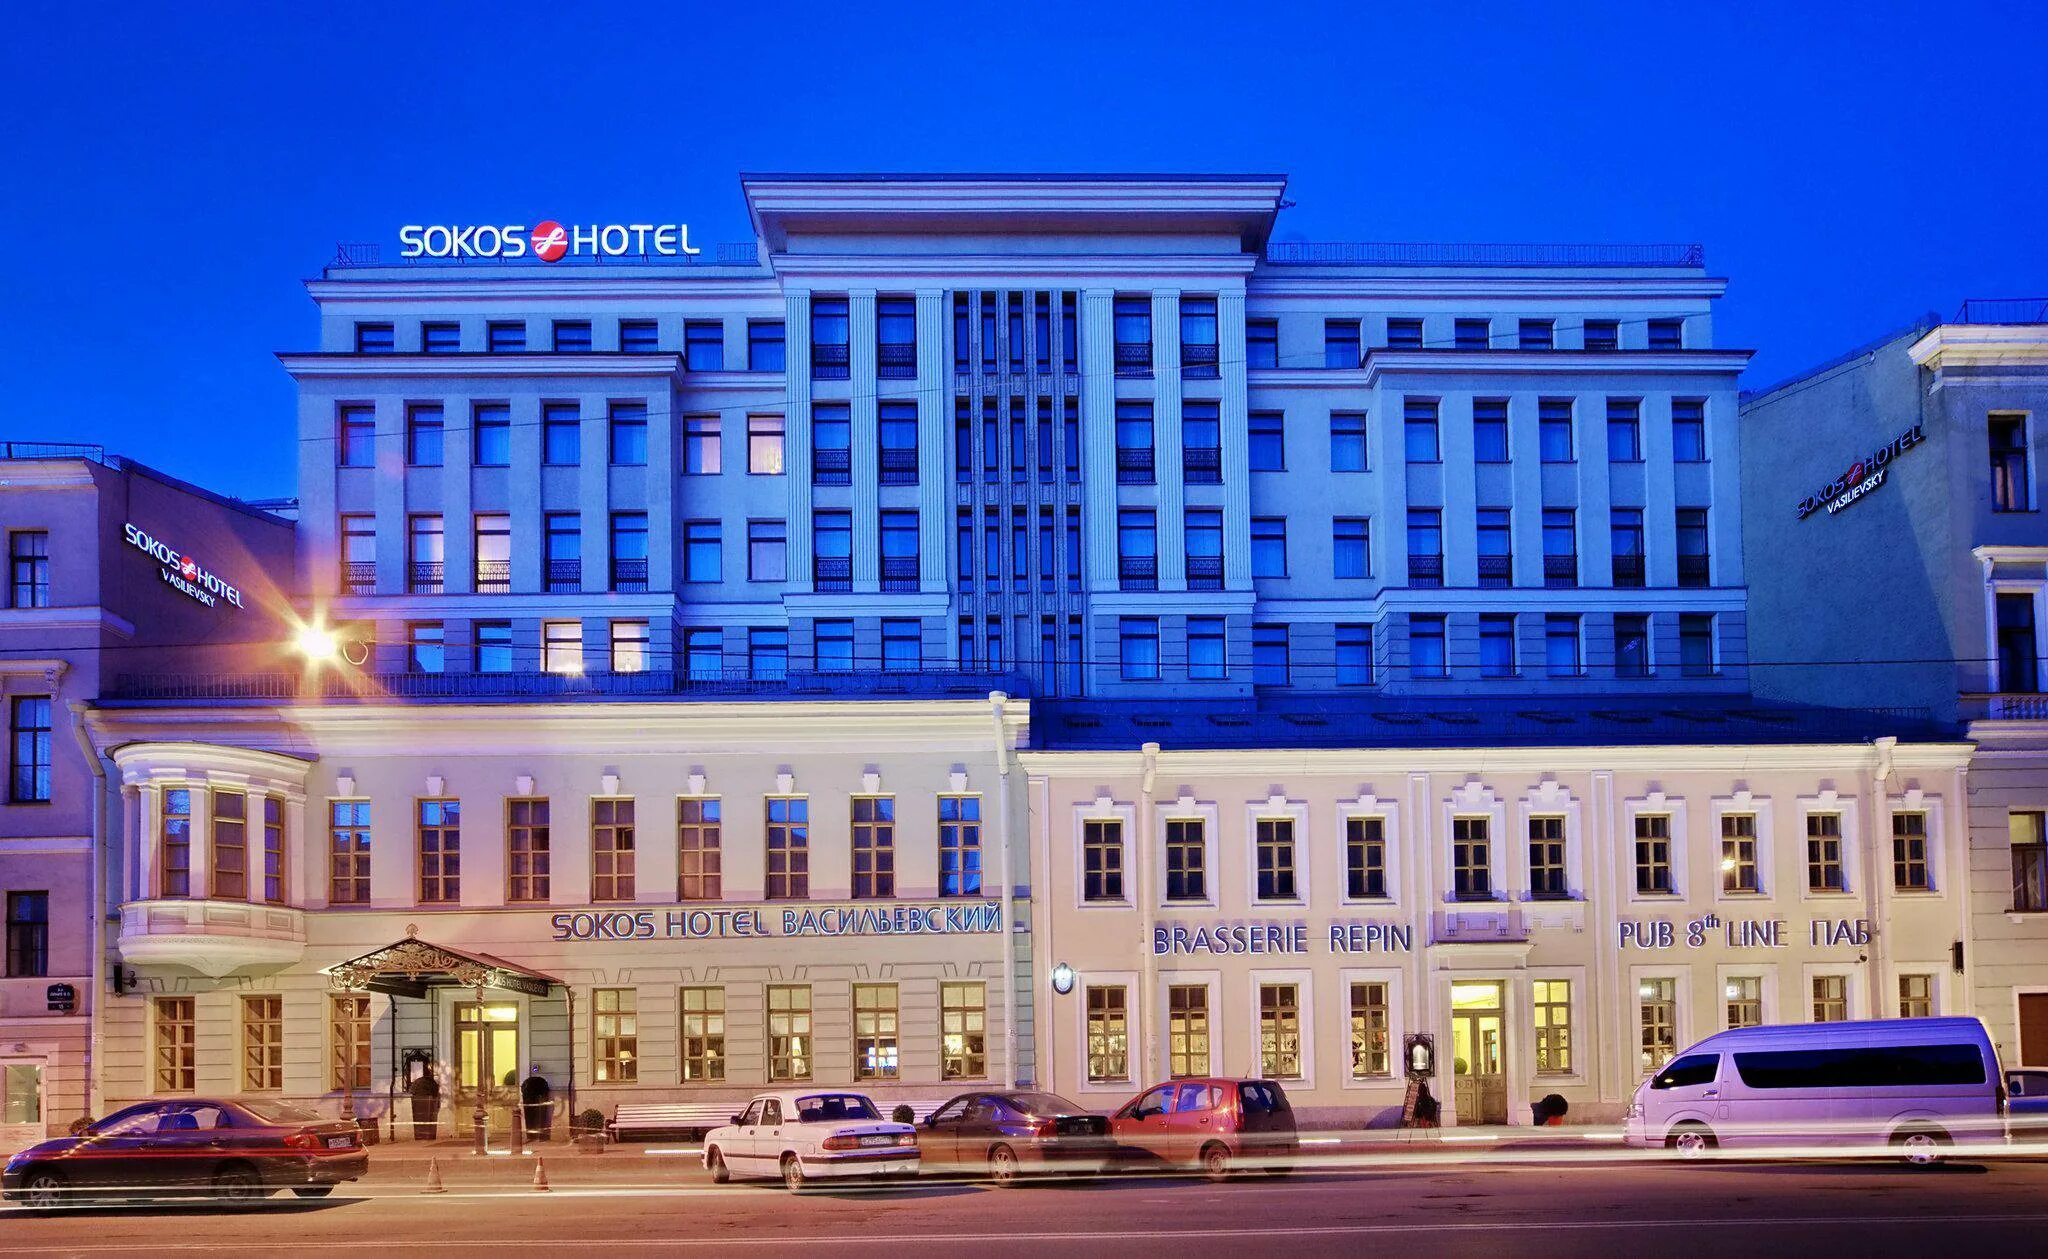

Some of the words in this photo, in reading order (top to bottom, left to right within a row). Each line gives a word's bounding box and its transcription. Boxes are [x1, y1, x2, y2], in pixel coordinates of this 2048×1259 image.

[400, 225, 526, 257] SOKOS
[573, 224, 700, 255] HOTEL
[1796, 475, 1845, 520] SOKOS
[1863, 425, 1922, 475] HOTEL
[1827, 469, 1885, 514] VASILIEVSKY
[125, 523, 181, 571] SOKOS
[197, 566, 245, 610] HOTEL
[161, 568, 216, 608] VASILIEVSKY
[551, 912, 656, 941] SOKOS
[666, 910, 770, 938] HOTEL
[782, 902, 1003, 936] ВАСИЛЬЕВСКИЙ
[1153, 925, 1309, 955] BRASSERIE
[1328, 924, 1412, 953] REPIN
[1618, 921, 1675, 949] PUB
[1727, 919, 1789, 948] LINE
[1810, 918, 1873, 947] ПАБ
